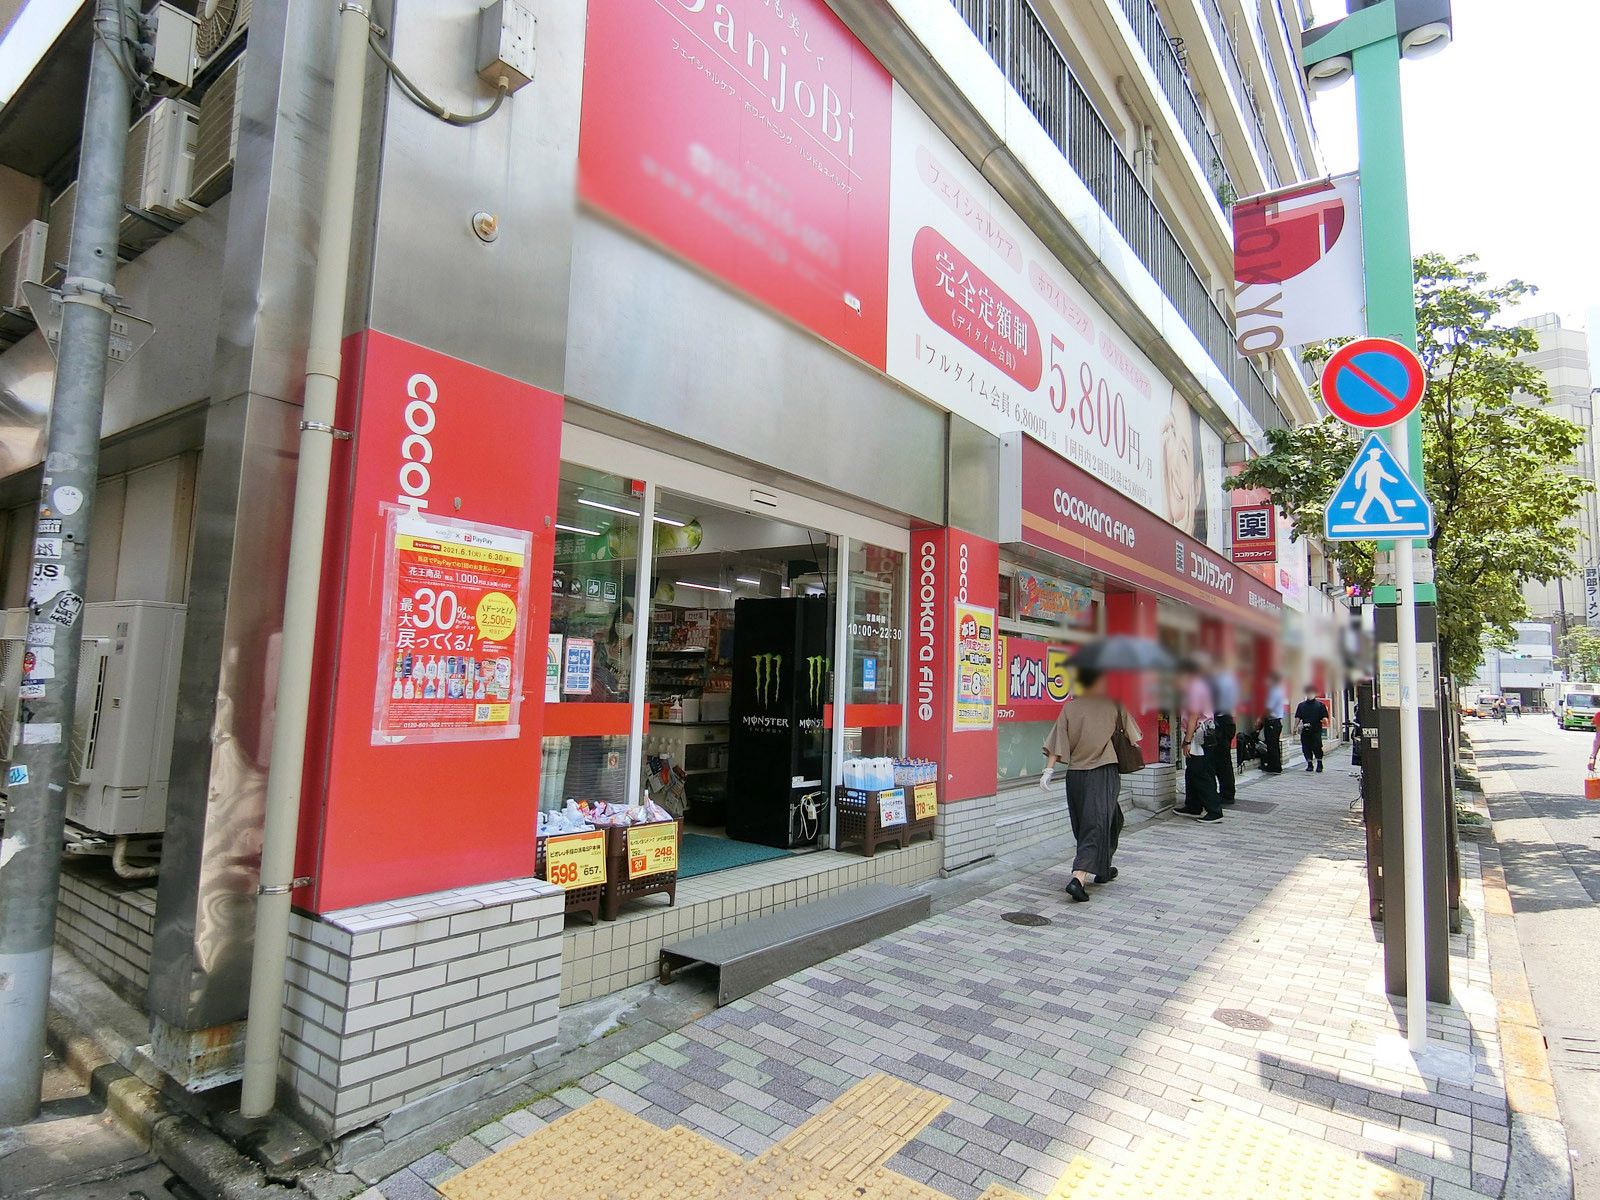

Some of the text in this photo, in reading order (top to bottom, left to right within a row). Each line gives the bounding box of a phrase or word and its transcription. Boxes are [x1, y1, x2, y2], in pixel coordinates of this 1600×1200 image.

[929, 163, 1014, 258] フェイシャルケア
[934, 250, 1029, 357] 完全定額制
[925, 344, 1011, 419] フルタイム会員
[472, 536, 493, 545] PayPay
[1239, 513, 1266, 537] 薬
[1190, 551, 1234, 595] ココカラファイン
[1586, 568, 1599, 619] 野郎ラーメン
[1010, 655, 1046, 699] ポイント
[743, 715, 789, 728] MONSTER
[655, 846, 673, 858] 248
[551, 861, 578, 886] 598
[583, 866, 599, 876] 657
